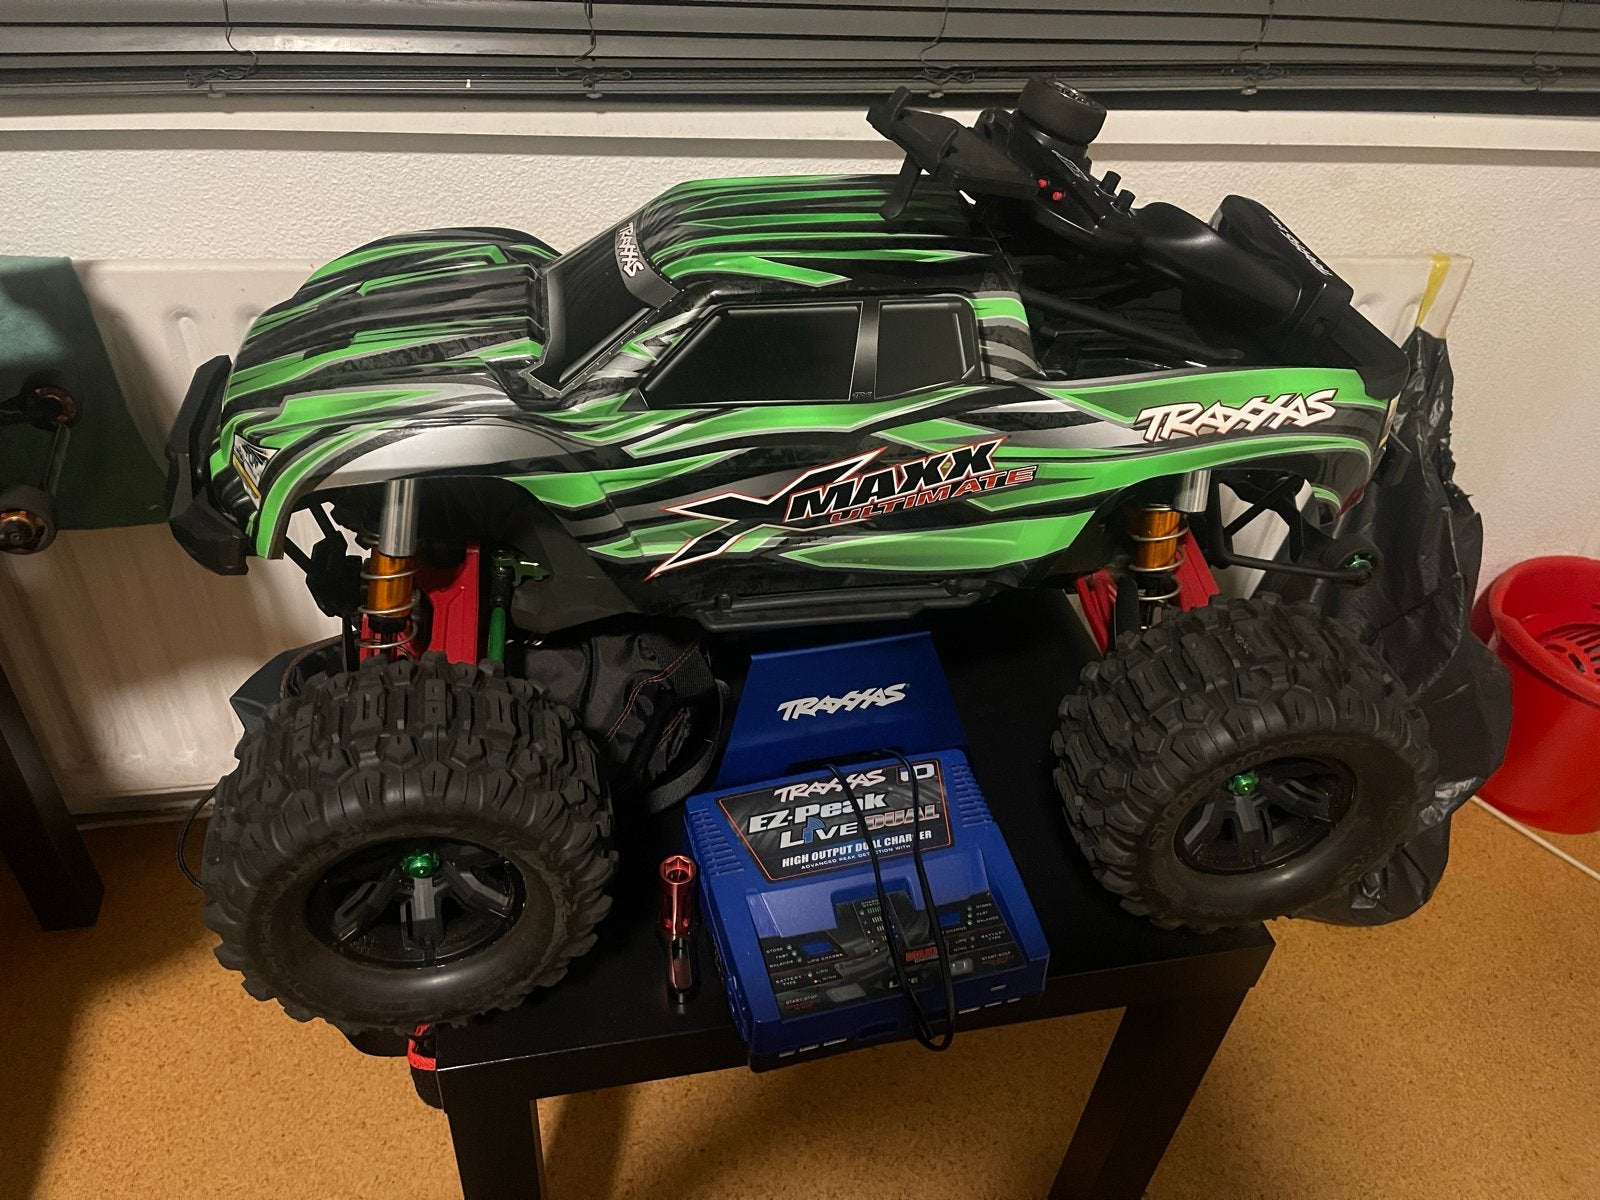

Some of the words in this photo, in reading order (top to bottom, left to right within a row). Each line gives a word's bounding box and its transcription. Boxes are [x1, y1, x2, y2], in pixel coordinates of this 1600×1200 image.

[618, 221, 645, 277] TRAXXAS
[1134, 388, 1339, 443] TRAXXAS
[830, 465, 1039, 523] ULTIMATE
[776, 682, 907, 722] TRAXXAS
[864, 804, 941, 831] DUAL
[782, 853, 810, 868] HIGH
[811, 844, 855, 861] OUTPUT
[884, 829, 933, 847] CHARER
[800, 858, 838, 870] ADVANCED
[838, 854, 856, 862] PEAK
[895, 843, 911, 851] WITH
